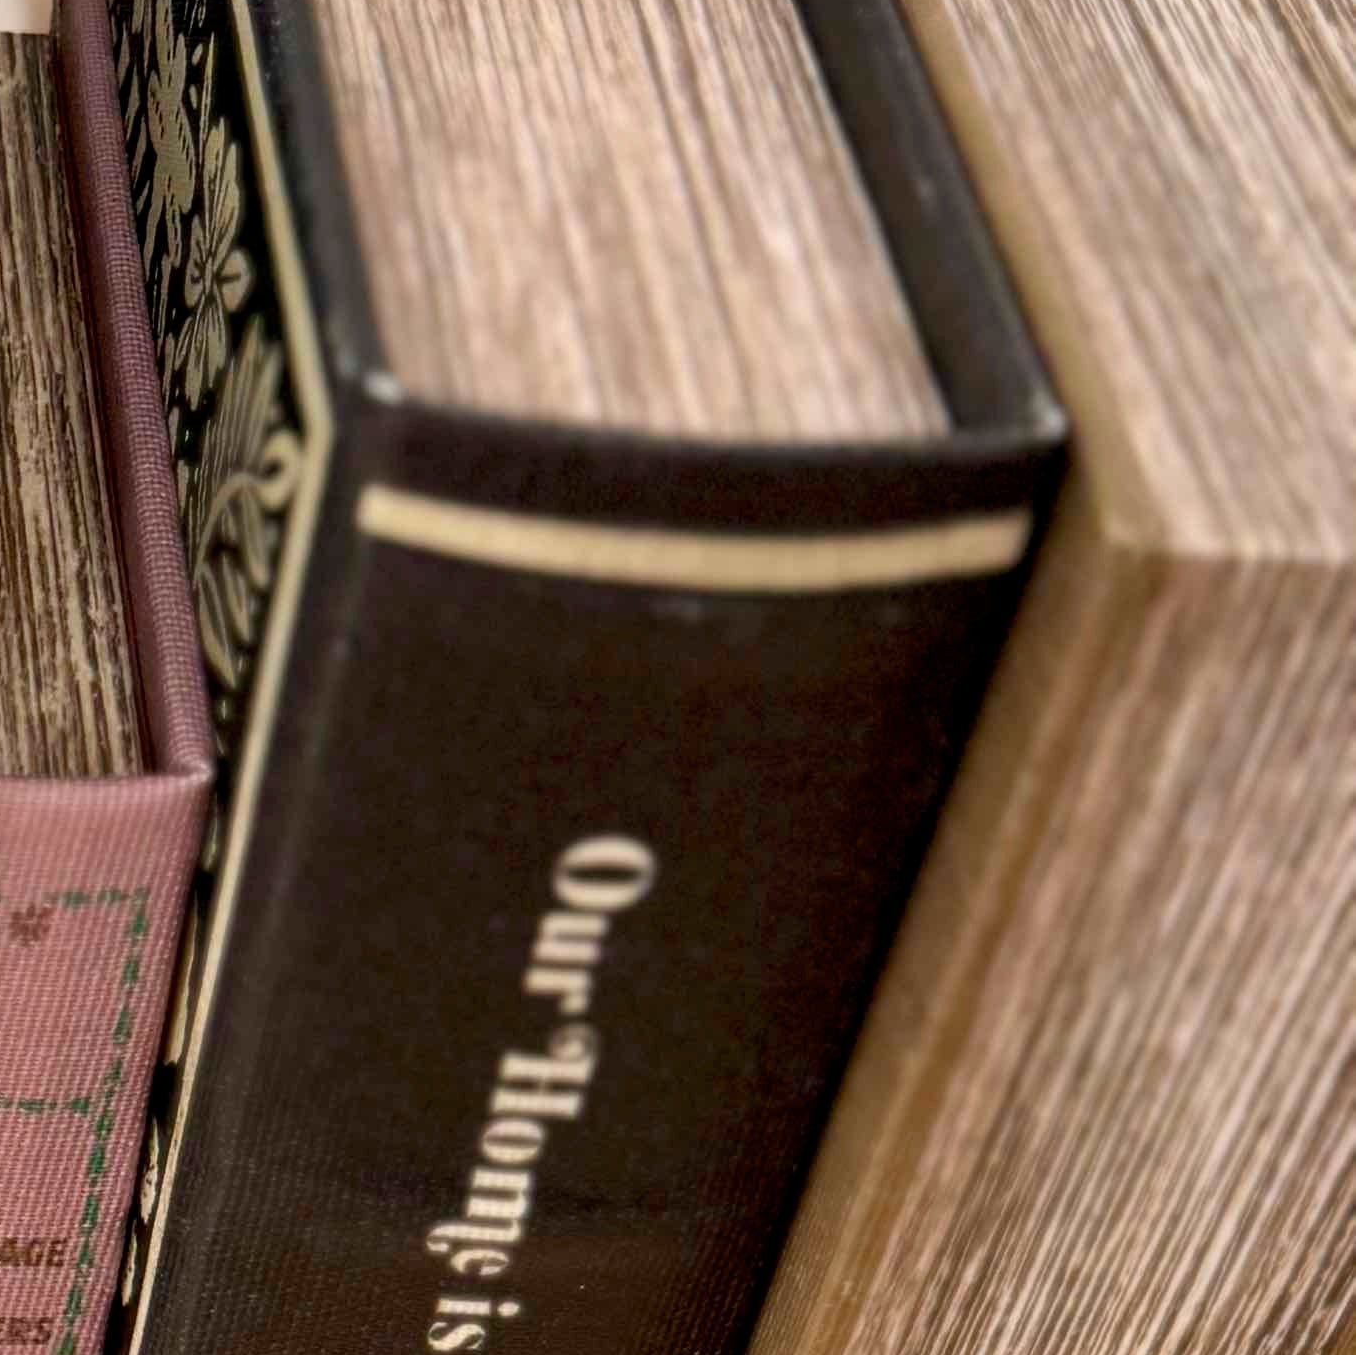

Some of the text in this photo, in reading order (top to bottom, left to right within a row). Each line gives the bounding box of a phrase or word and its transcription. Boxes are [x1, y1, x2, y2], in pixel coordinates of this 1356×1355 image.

[522, 832, 657, 1017] Our
[425, 1020, 598, 1278] Home
[426, 1297, 521, 1352] is
